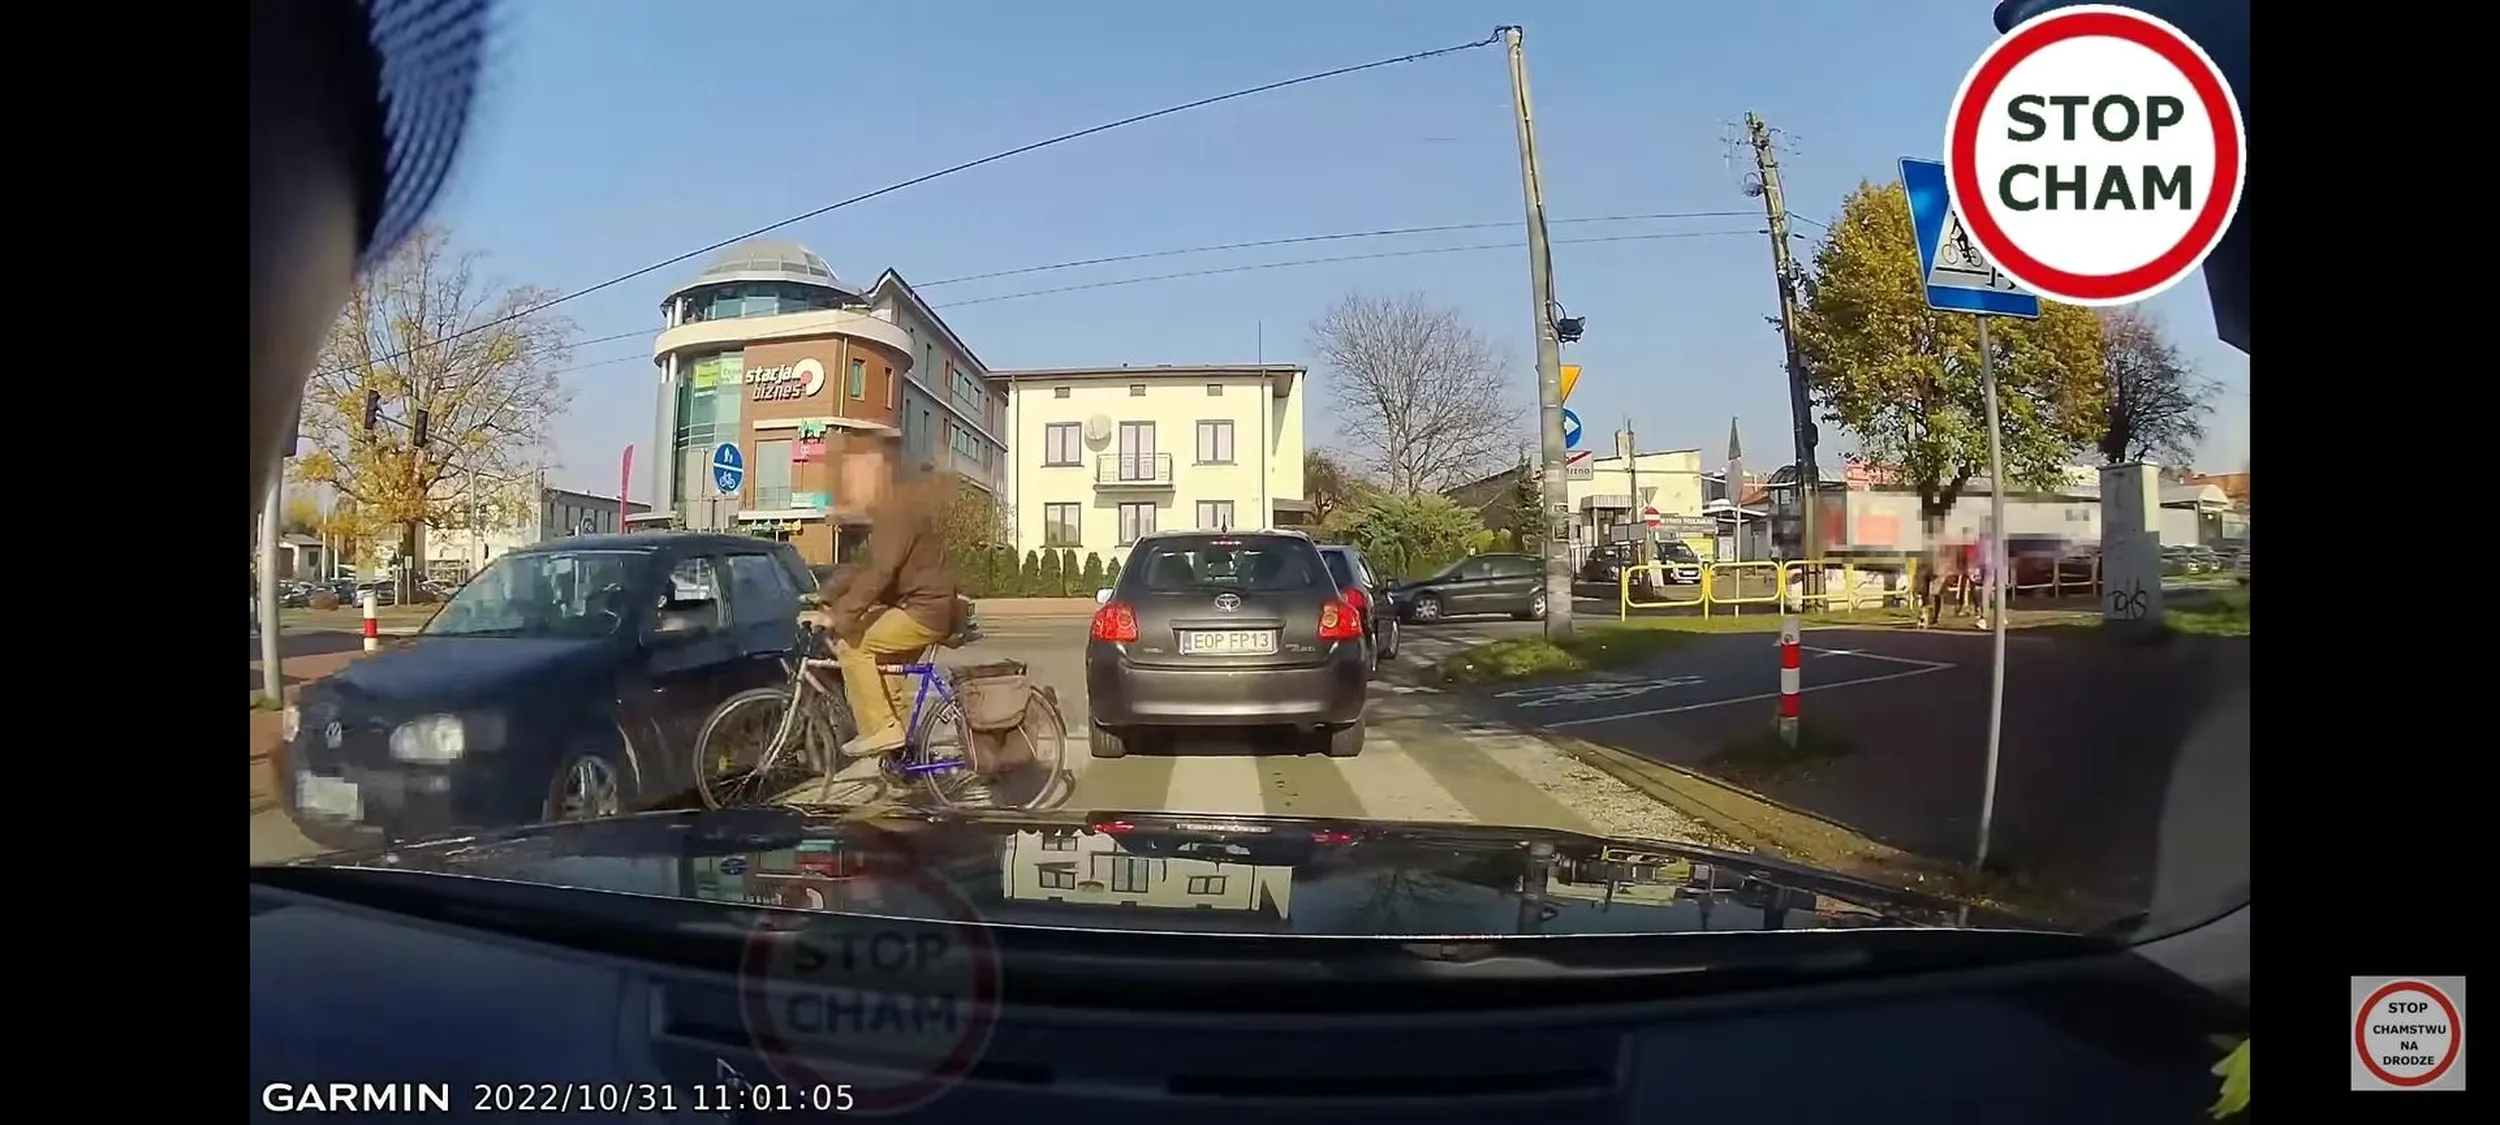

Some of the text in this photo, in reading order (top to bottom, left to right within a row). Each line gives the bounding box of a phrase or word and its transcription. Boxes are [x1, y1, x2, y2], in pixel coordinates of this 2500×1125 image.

[745, 364, 794, 384] stacja
[752, 383, 804, 401] biznes
[1194, 633, 1225, 649] EOP
[1229, 632, 1270, 648] FP13
